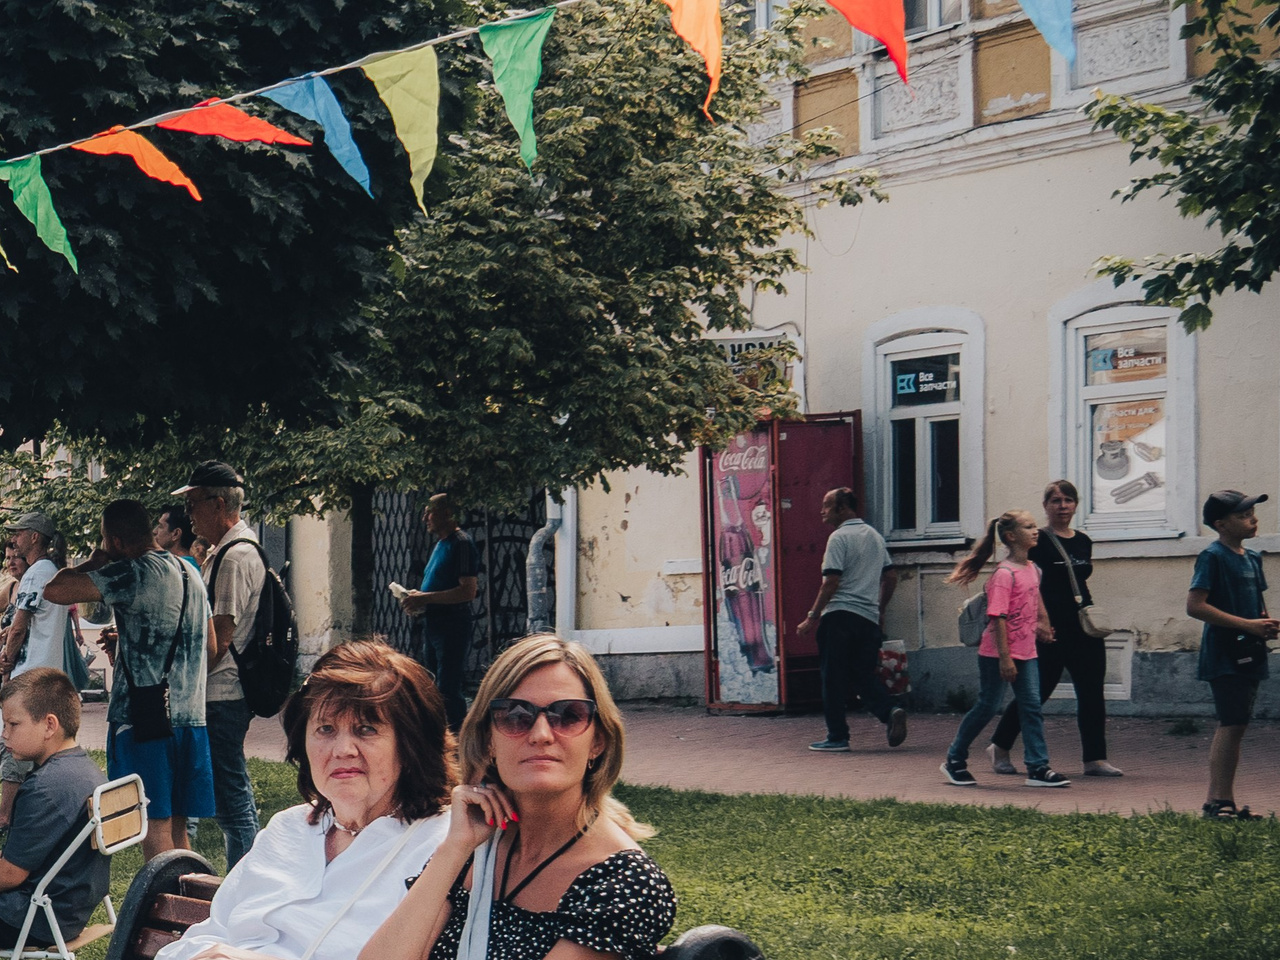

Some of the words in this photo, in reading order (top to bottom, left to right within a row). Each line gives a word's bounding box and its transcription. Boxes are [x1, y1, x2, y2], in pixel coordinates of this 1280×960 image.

[1118, 346, 1136, 358] Все
[1118, 356, 1162, 369] запчасти
[918, 371, 934, 382] Все
[918, 380, 957, 393] запчасти
